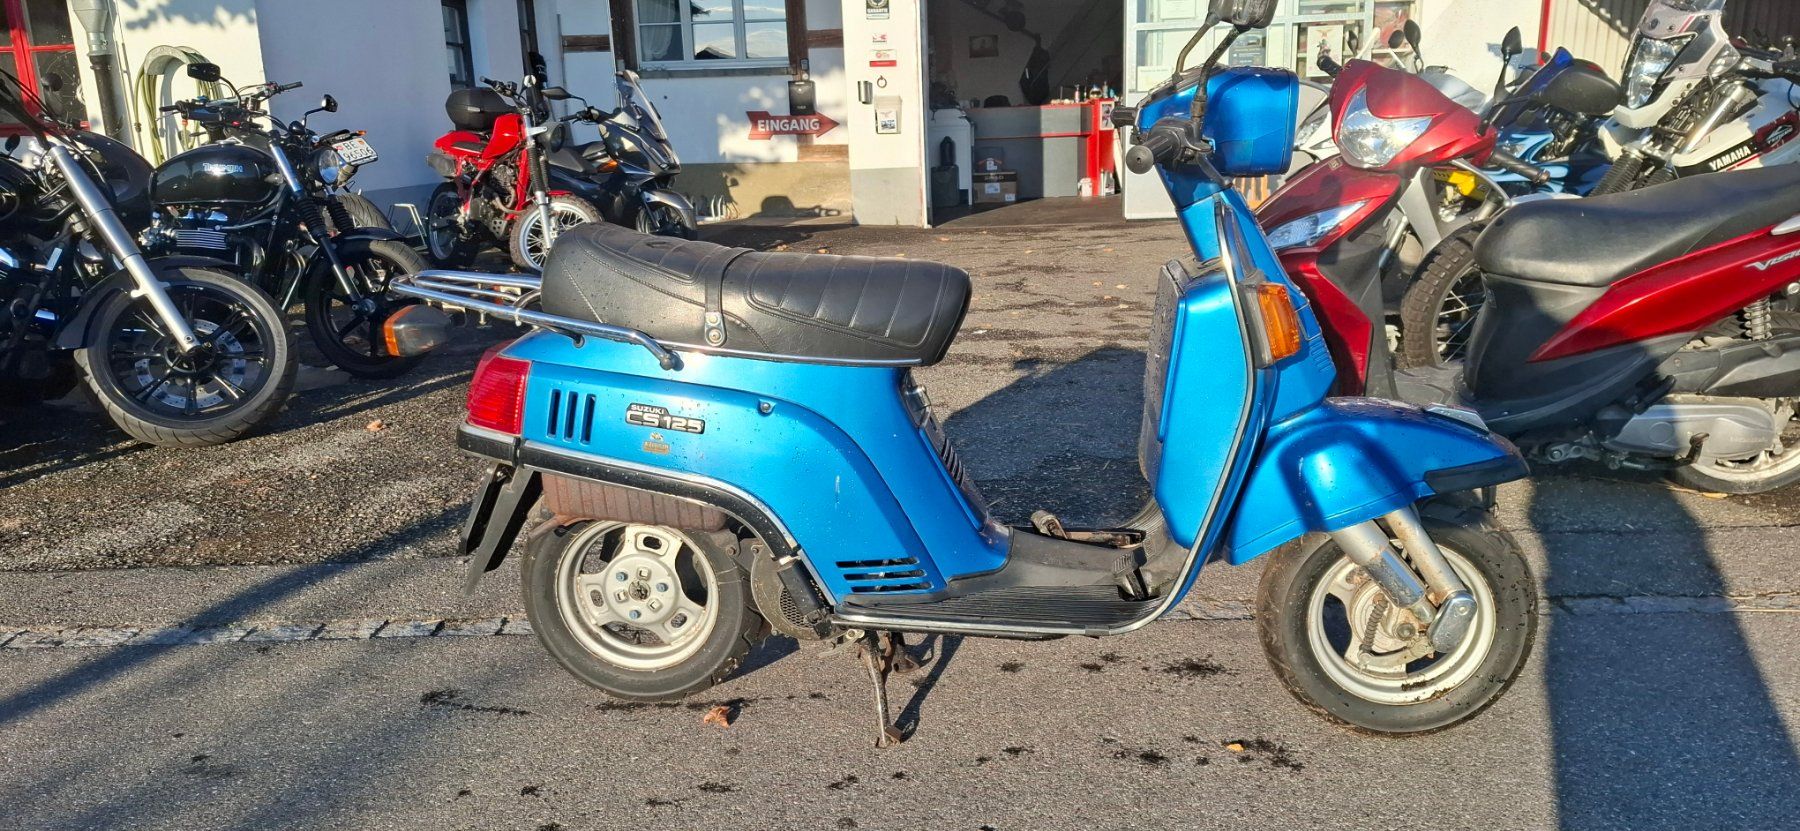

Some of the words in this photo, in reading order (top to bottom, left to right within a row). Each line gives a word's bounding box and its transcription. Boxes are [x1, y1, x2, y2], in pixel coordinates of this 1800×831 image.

[758, 119, 819, 132] EINGANG
[343, 141, 358, 150] BE
[1709, 145, 1751, 171] YAMAHA
[630, 404, 665, 415] SUZUKI
[626, 410, 660, 427] CS
[663, 415, 704, 433] 125
